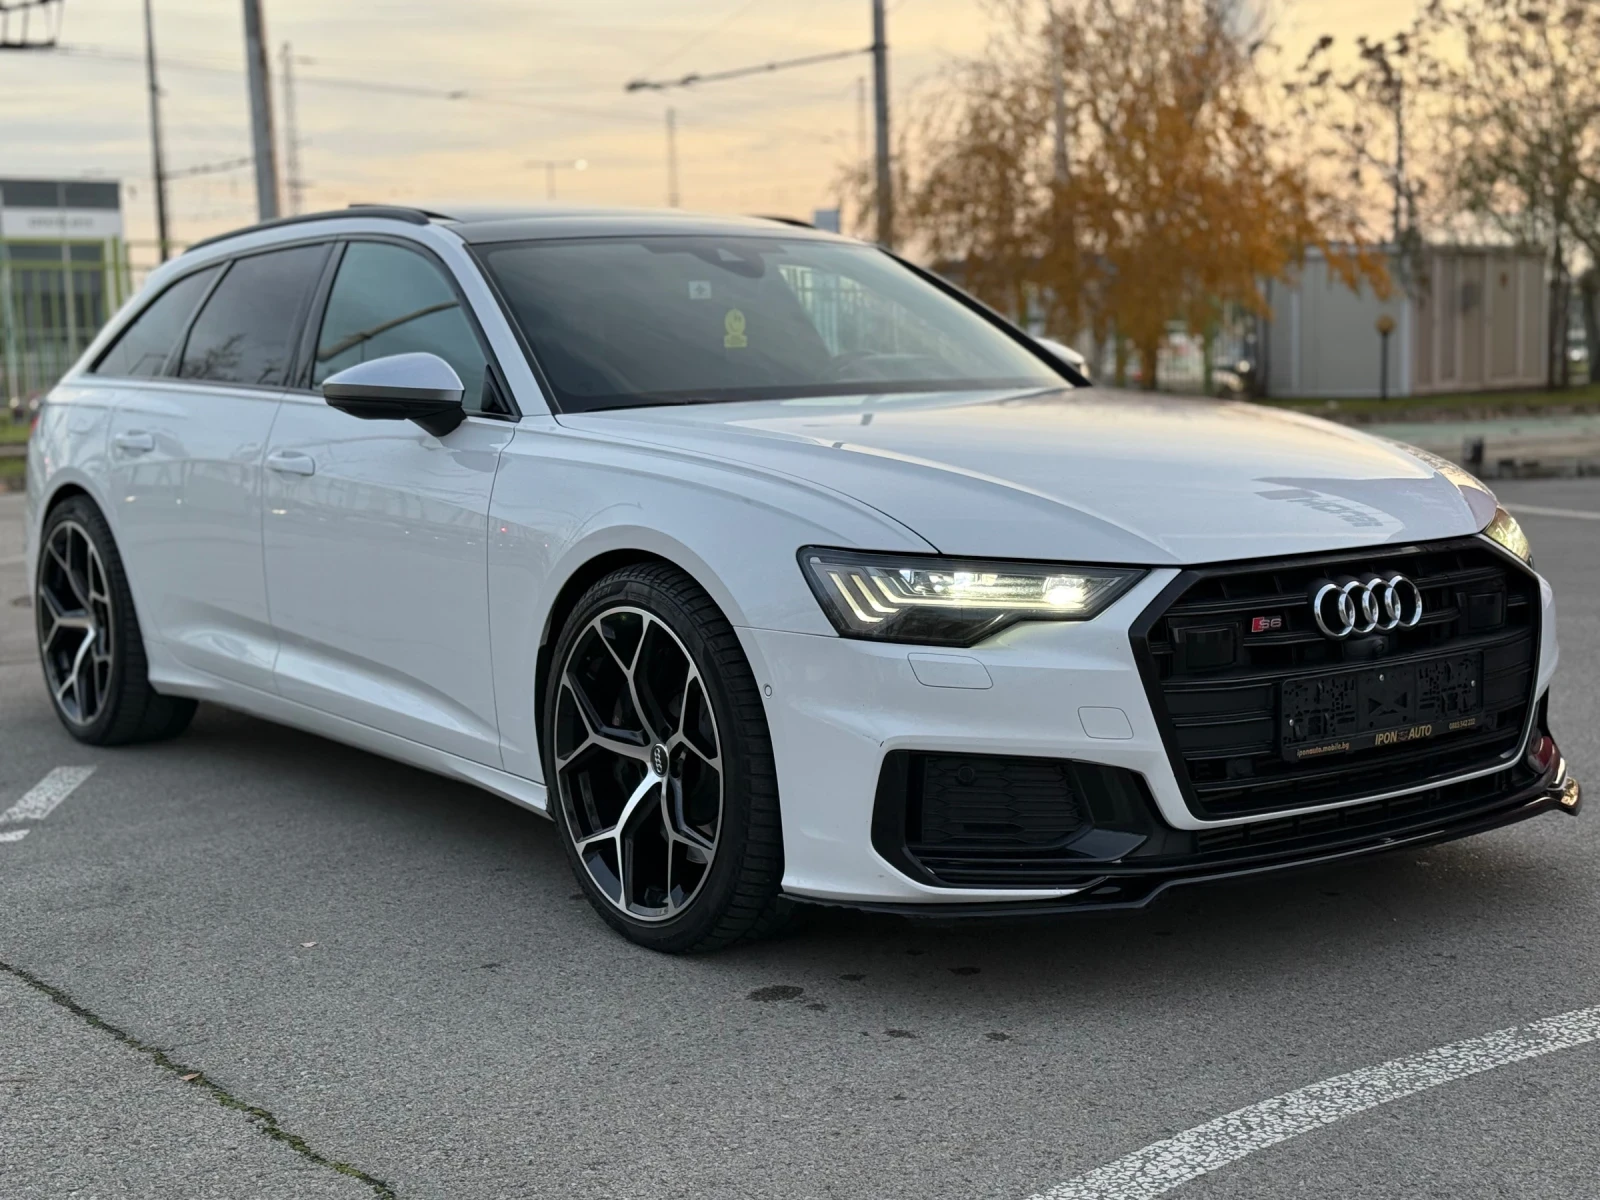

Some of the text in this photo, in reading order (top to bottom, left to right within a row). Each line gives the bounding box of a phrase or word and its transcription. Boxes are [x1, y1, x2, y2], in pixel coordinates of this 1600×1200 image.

[1256, 617, 1282, 630] S6
[1375, 724, 1432, 746] IPON AUTO
[1296, 742, 1350, 758] iponauto.mobile.bg
